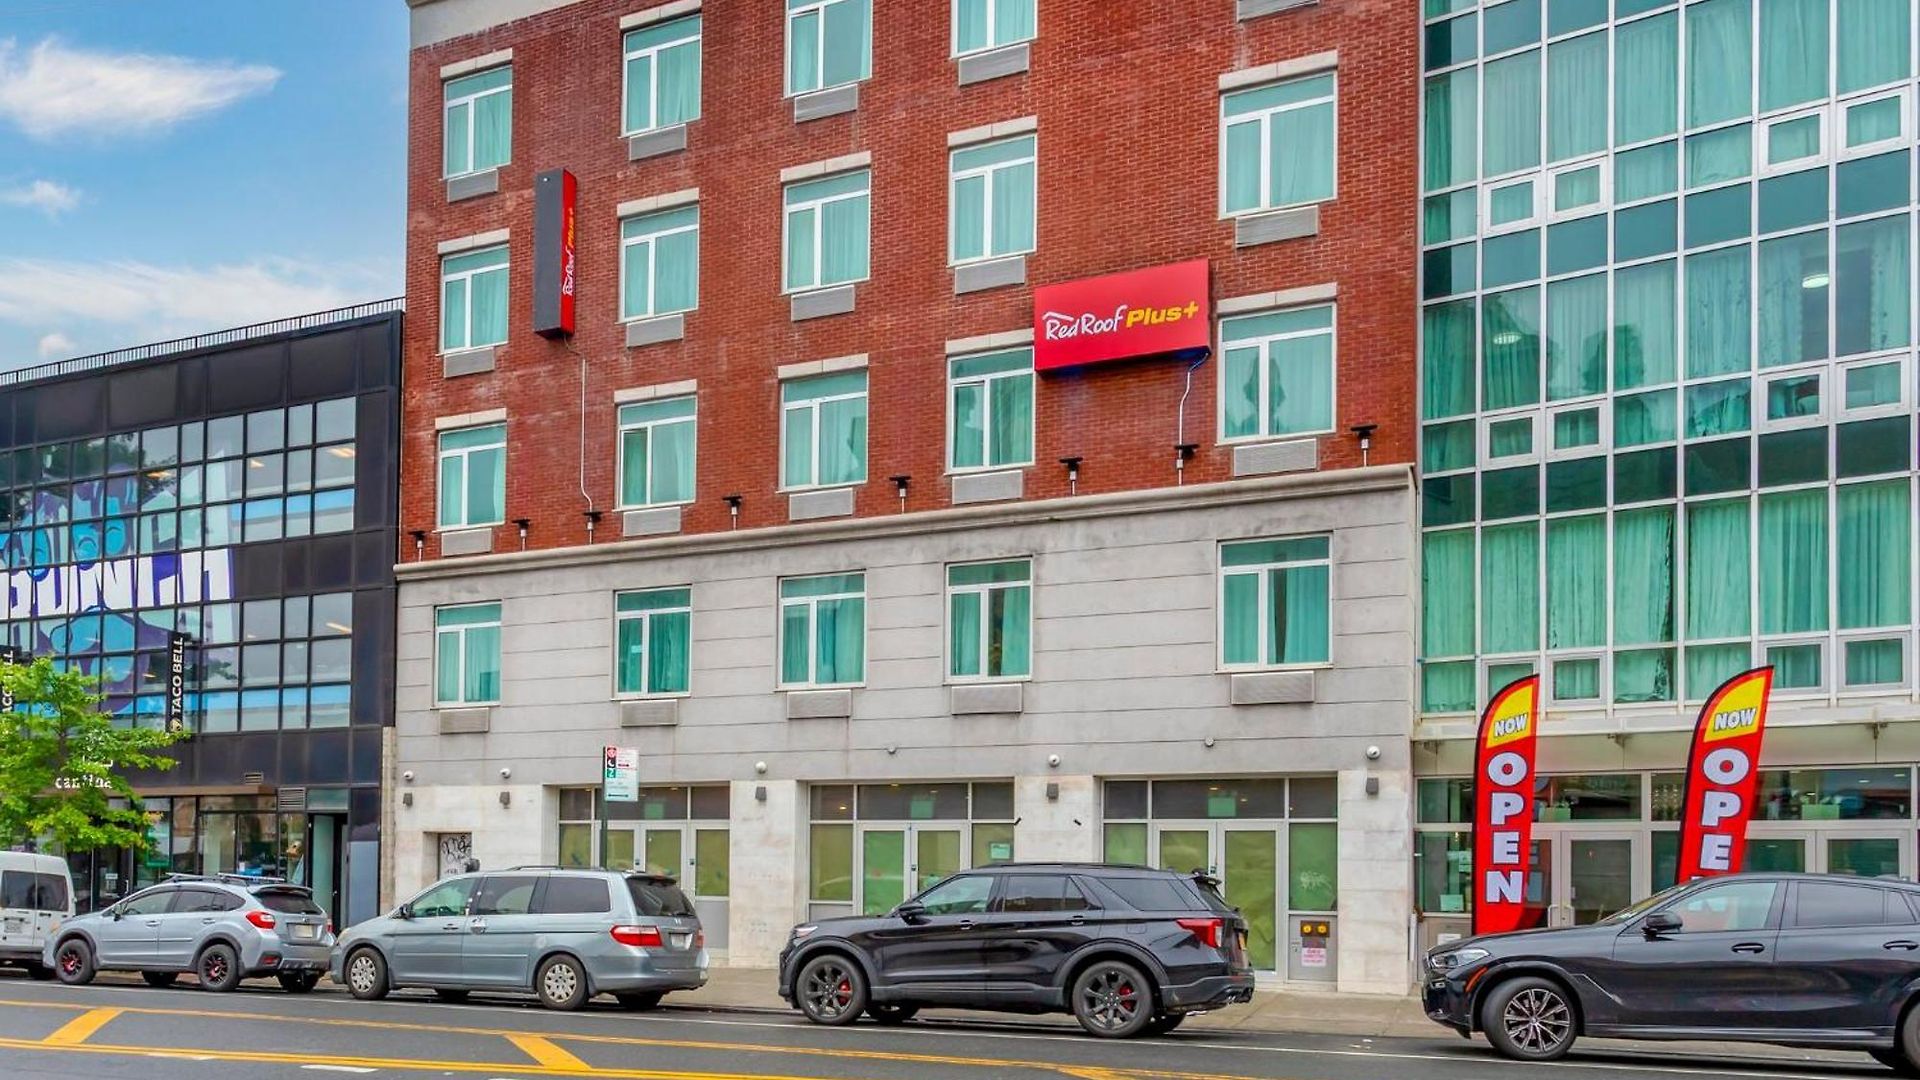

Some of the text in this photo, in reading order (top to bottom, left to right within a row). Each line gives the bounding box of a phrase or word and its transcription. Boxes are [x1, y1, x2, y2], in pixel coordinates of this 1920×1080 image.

[172, 637, 183, 715] TACO BELL
[1493, 712, 1528, 738] NOW
[1714, 707, 1757, 732] NOW
[1486, 751, 1528, 904] OPEN
